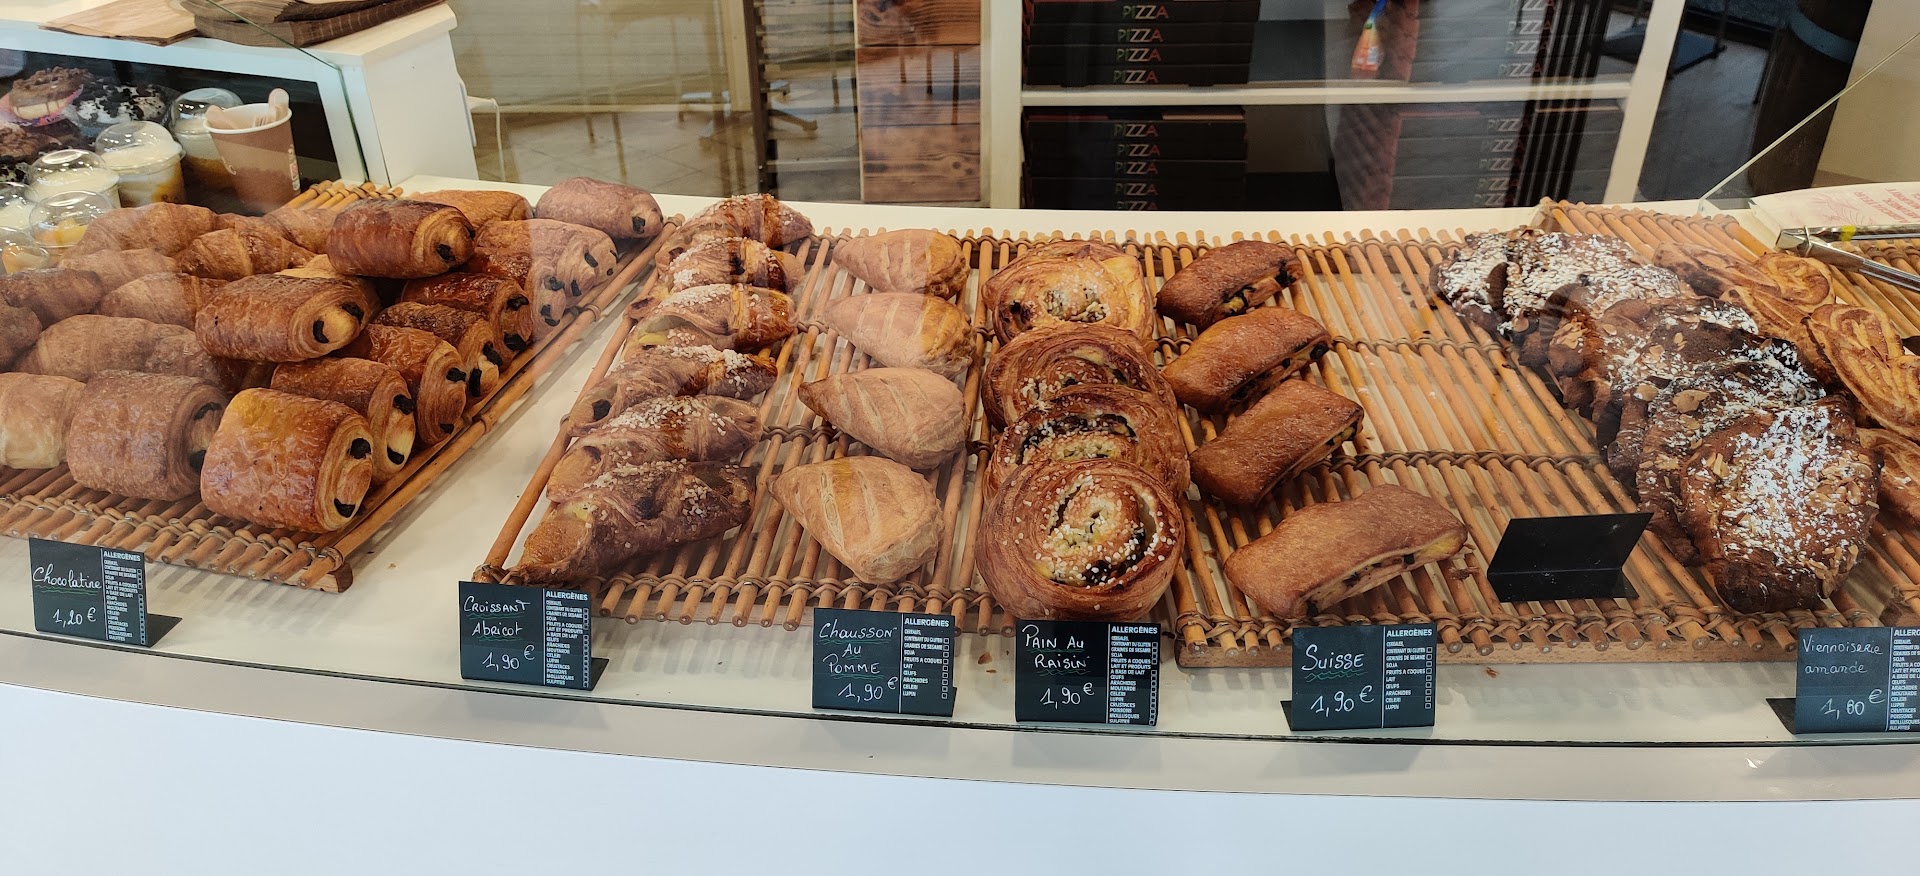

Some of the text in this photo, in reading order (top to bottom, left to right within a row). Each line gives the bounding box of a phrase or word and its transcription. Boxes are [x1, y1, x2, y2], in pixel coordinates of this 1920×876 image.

[1123, 6, 1168, 19] PIZZA
[1118, 29, 1164, 42] PIZZA
[1117, 48, 1162, 61] PIZZA
[1114, 70, 1158, 83] PIZZA
[1114, 124, 1158, 137] PIZZA
[1118, 144, 1160, 156] PIZZA
[1115, 162, 1158, 174] PIZZA
[1115, 183, 1158, 196] PIZZA
[33, 564, 102, 589] Chocolatine
[546, 591, 588, 600] ALLERGÈNES
[53, 609, 82, 628] 1,20
[904, 618, 949, 627] ALLERGÈNES
[1111, 626, 1157, 634] ALLERGÈNES
[1387, 628, 1432, 637] ALLERGÈNES
[482, 652, 519, 671] 1,90
[1805, 661, 1868, 674] amande
[838, 683, 883, 703] 1,90
[1040, 687, 1080, 709] 1,90
[1310, 691, 1354, 717] 1,90
